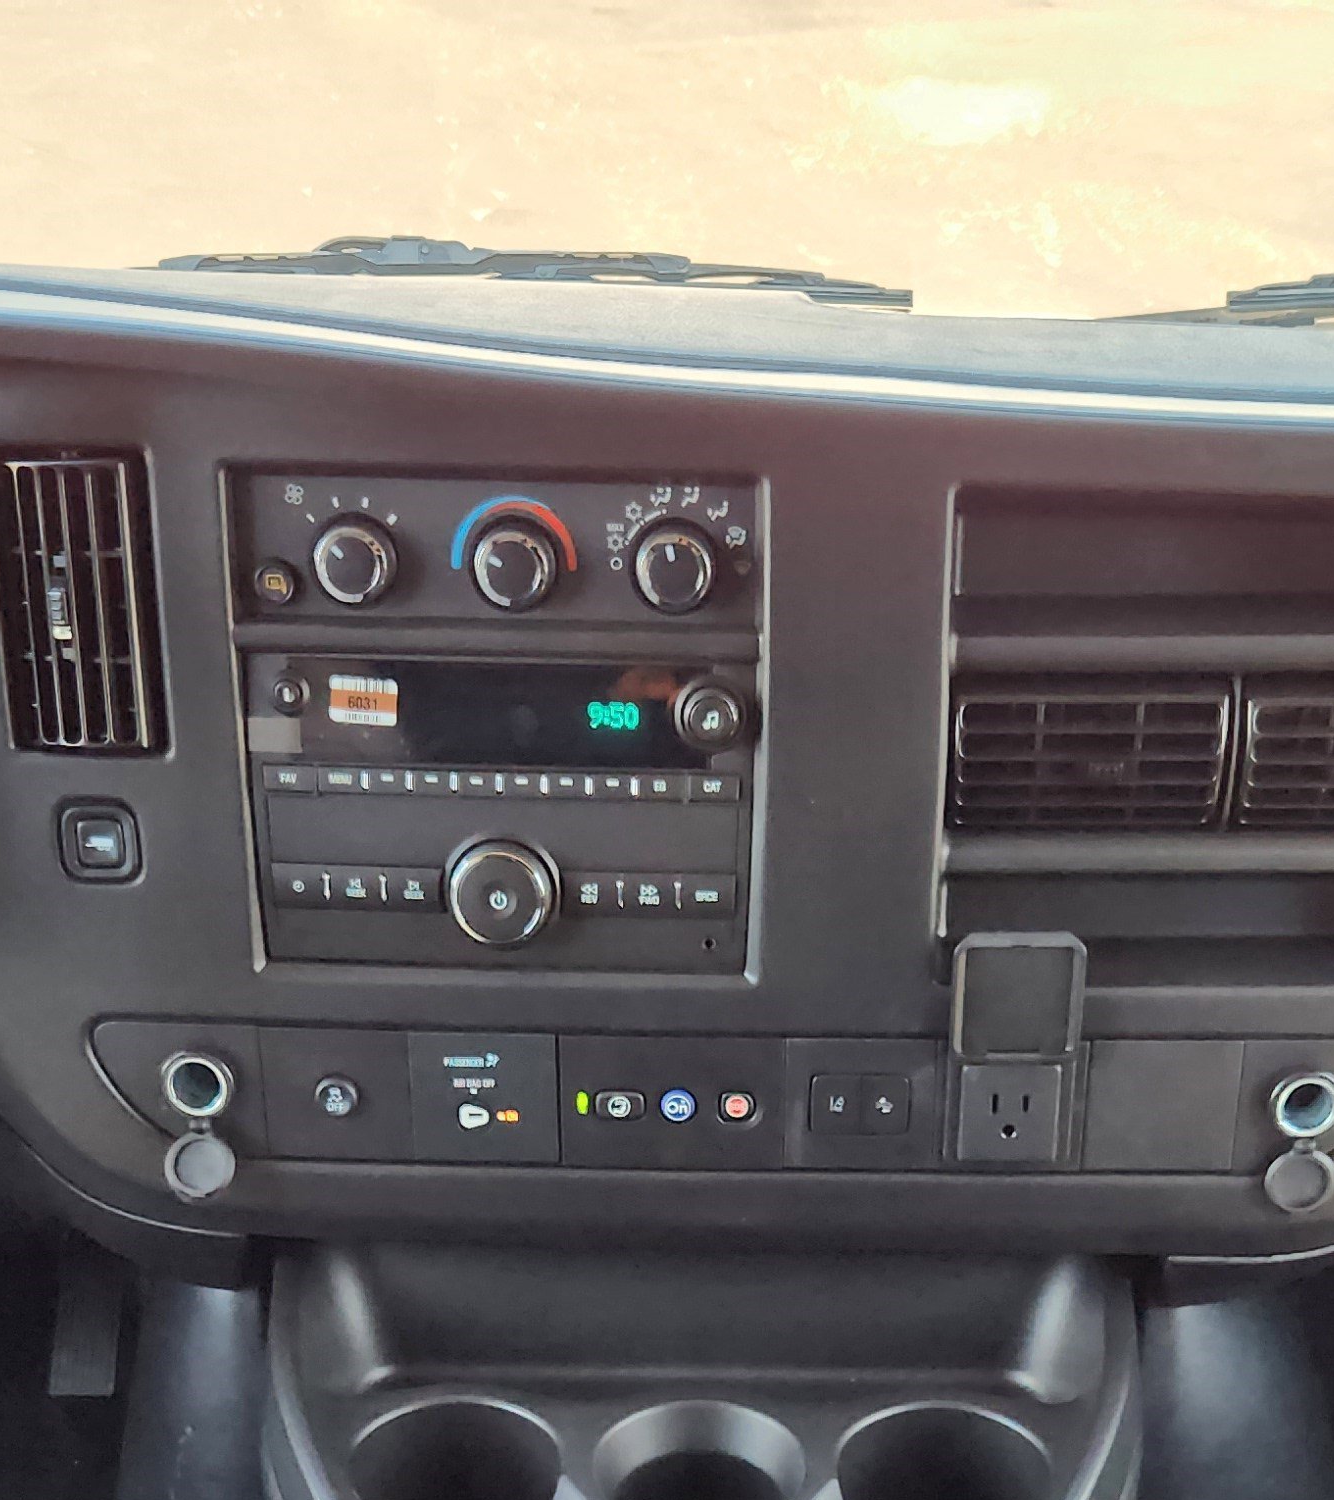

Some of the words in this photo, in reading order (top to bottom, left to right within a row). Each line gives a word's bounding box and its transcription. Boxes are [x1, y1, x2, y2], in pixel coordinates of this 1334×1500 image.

[348, 695, 378, 711] 6031
[587, 701, 640, 730] 9:50
[278, 772, 298, 784] FAV
[703, 779, 722, 793] CAT
[326, 1101, 344, 1112] OFF
